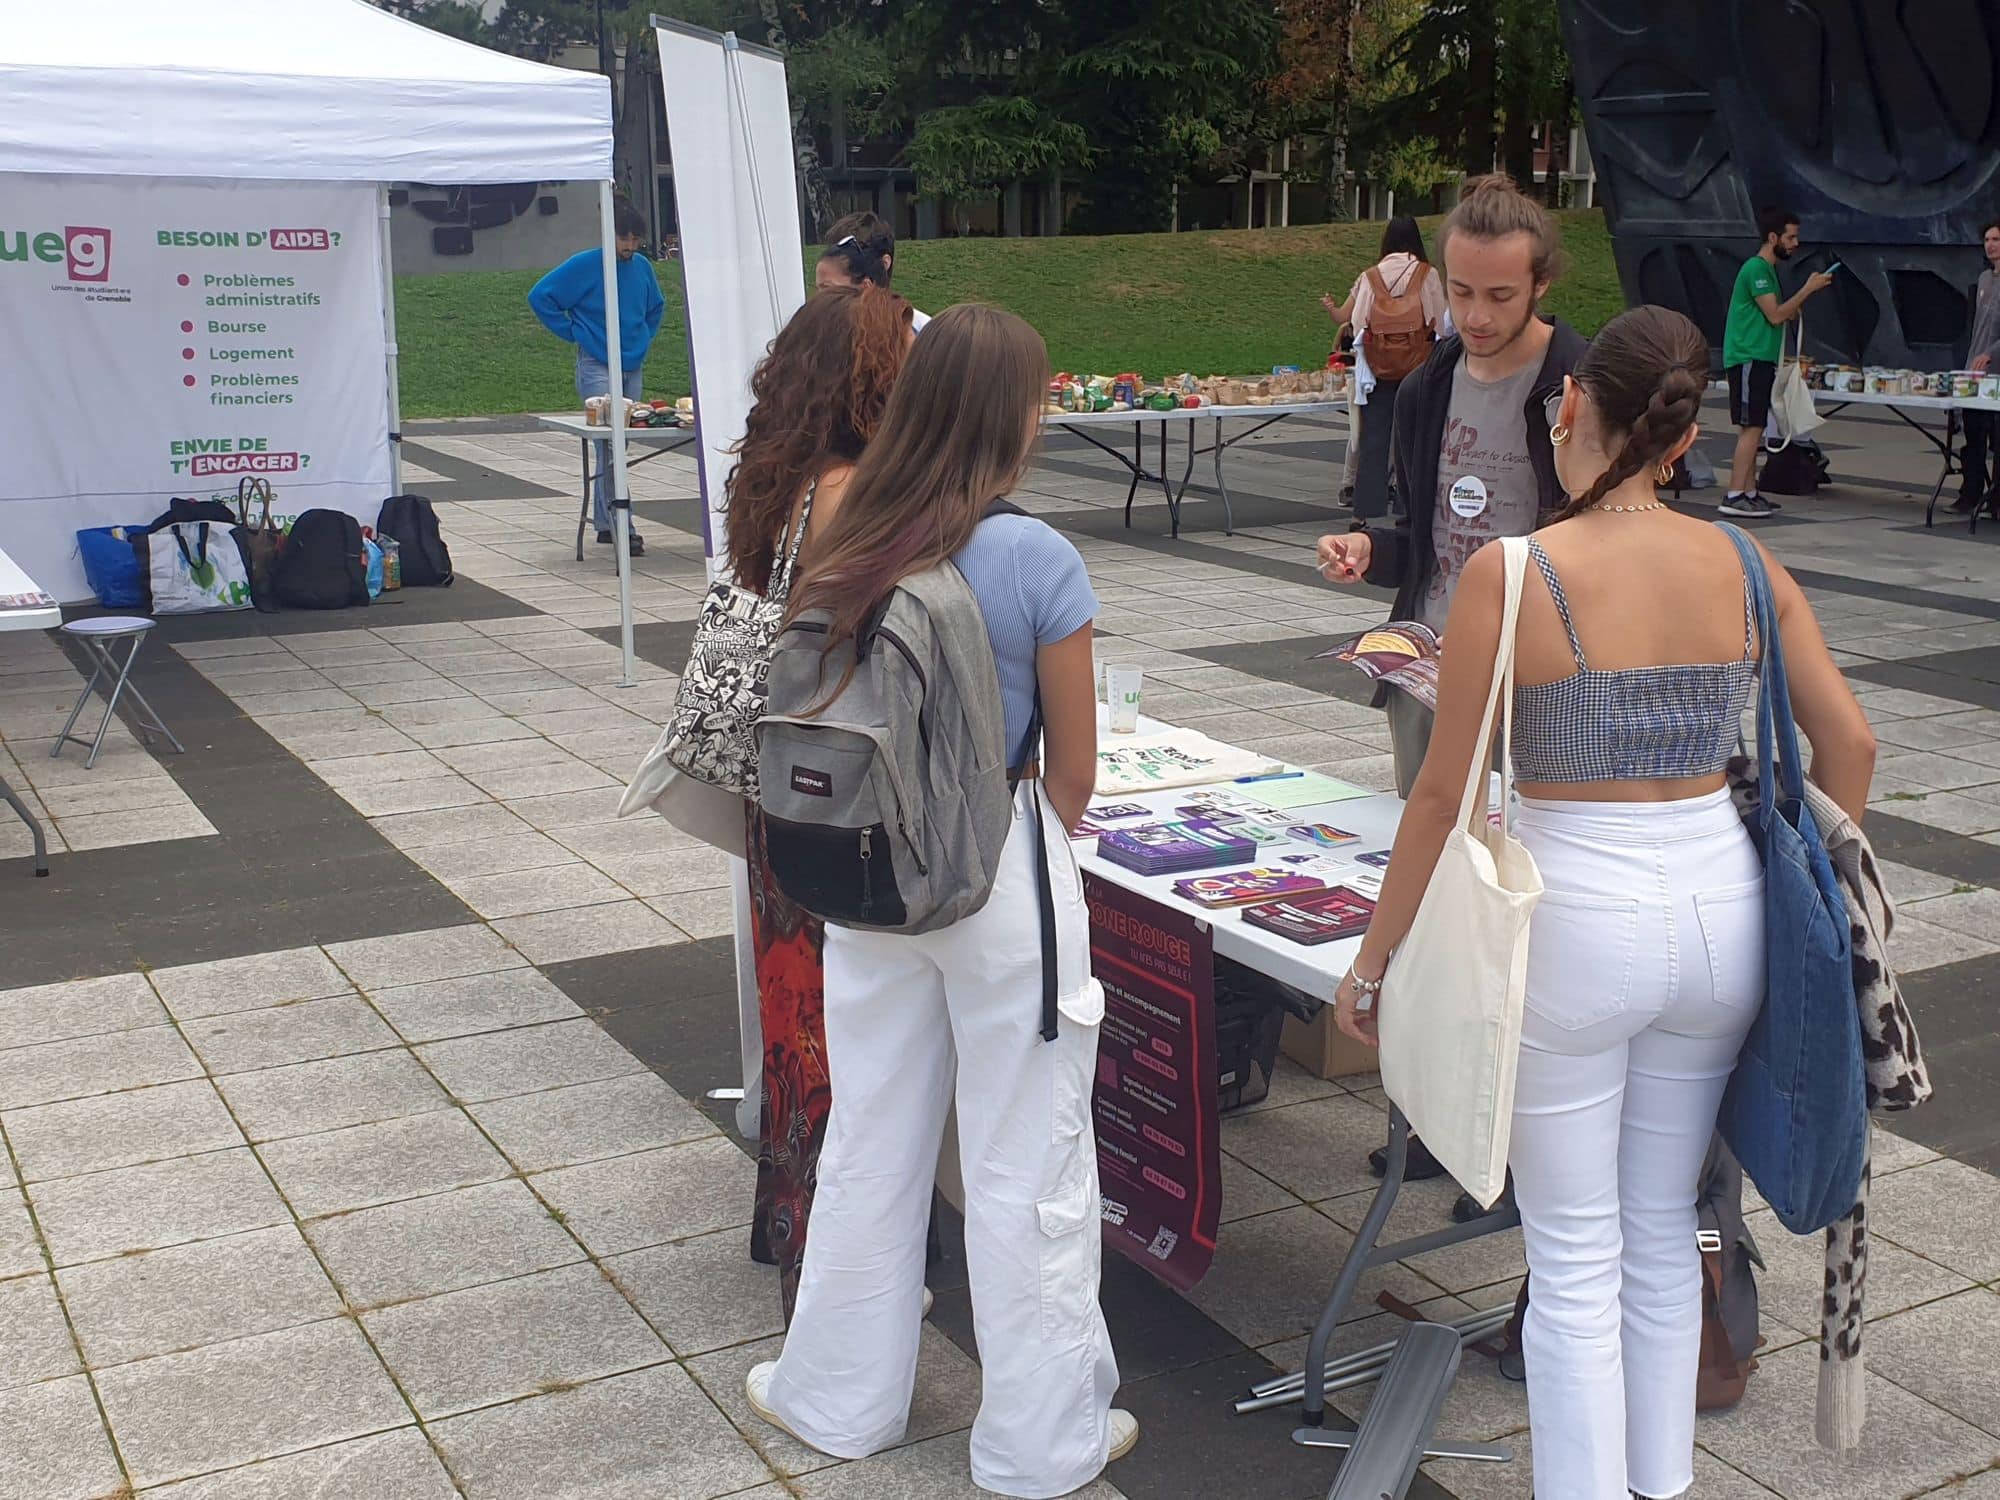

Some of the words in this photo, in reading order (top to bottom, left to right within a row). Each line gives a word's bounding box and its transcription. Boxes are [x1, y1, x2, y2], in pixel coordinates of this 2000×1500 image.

[157, 230, 240, 247] BESOIN
[0, 231, 106, 276] ueg
[204, 273, 295, 287] Problèmes
[206, 292, 321, 306] administratifs
[208, 320, 267, 333] Bourse
[210, 347, 294, 362] Logement
[210, 373, 299, 387] Problèmes
[210, 391, 294, 405] financiers
[170, 438, 232, 456] ENVIE
[239, 438, 268, 452] DE
[1128, 916, 1191, 967] ROUGE
[1124, 991, 1181, 1025] accompagnement
